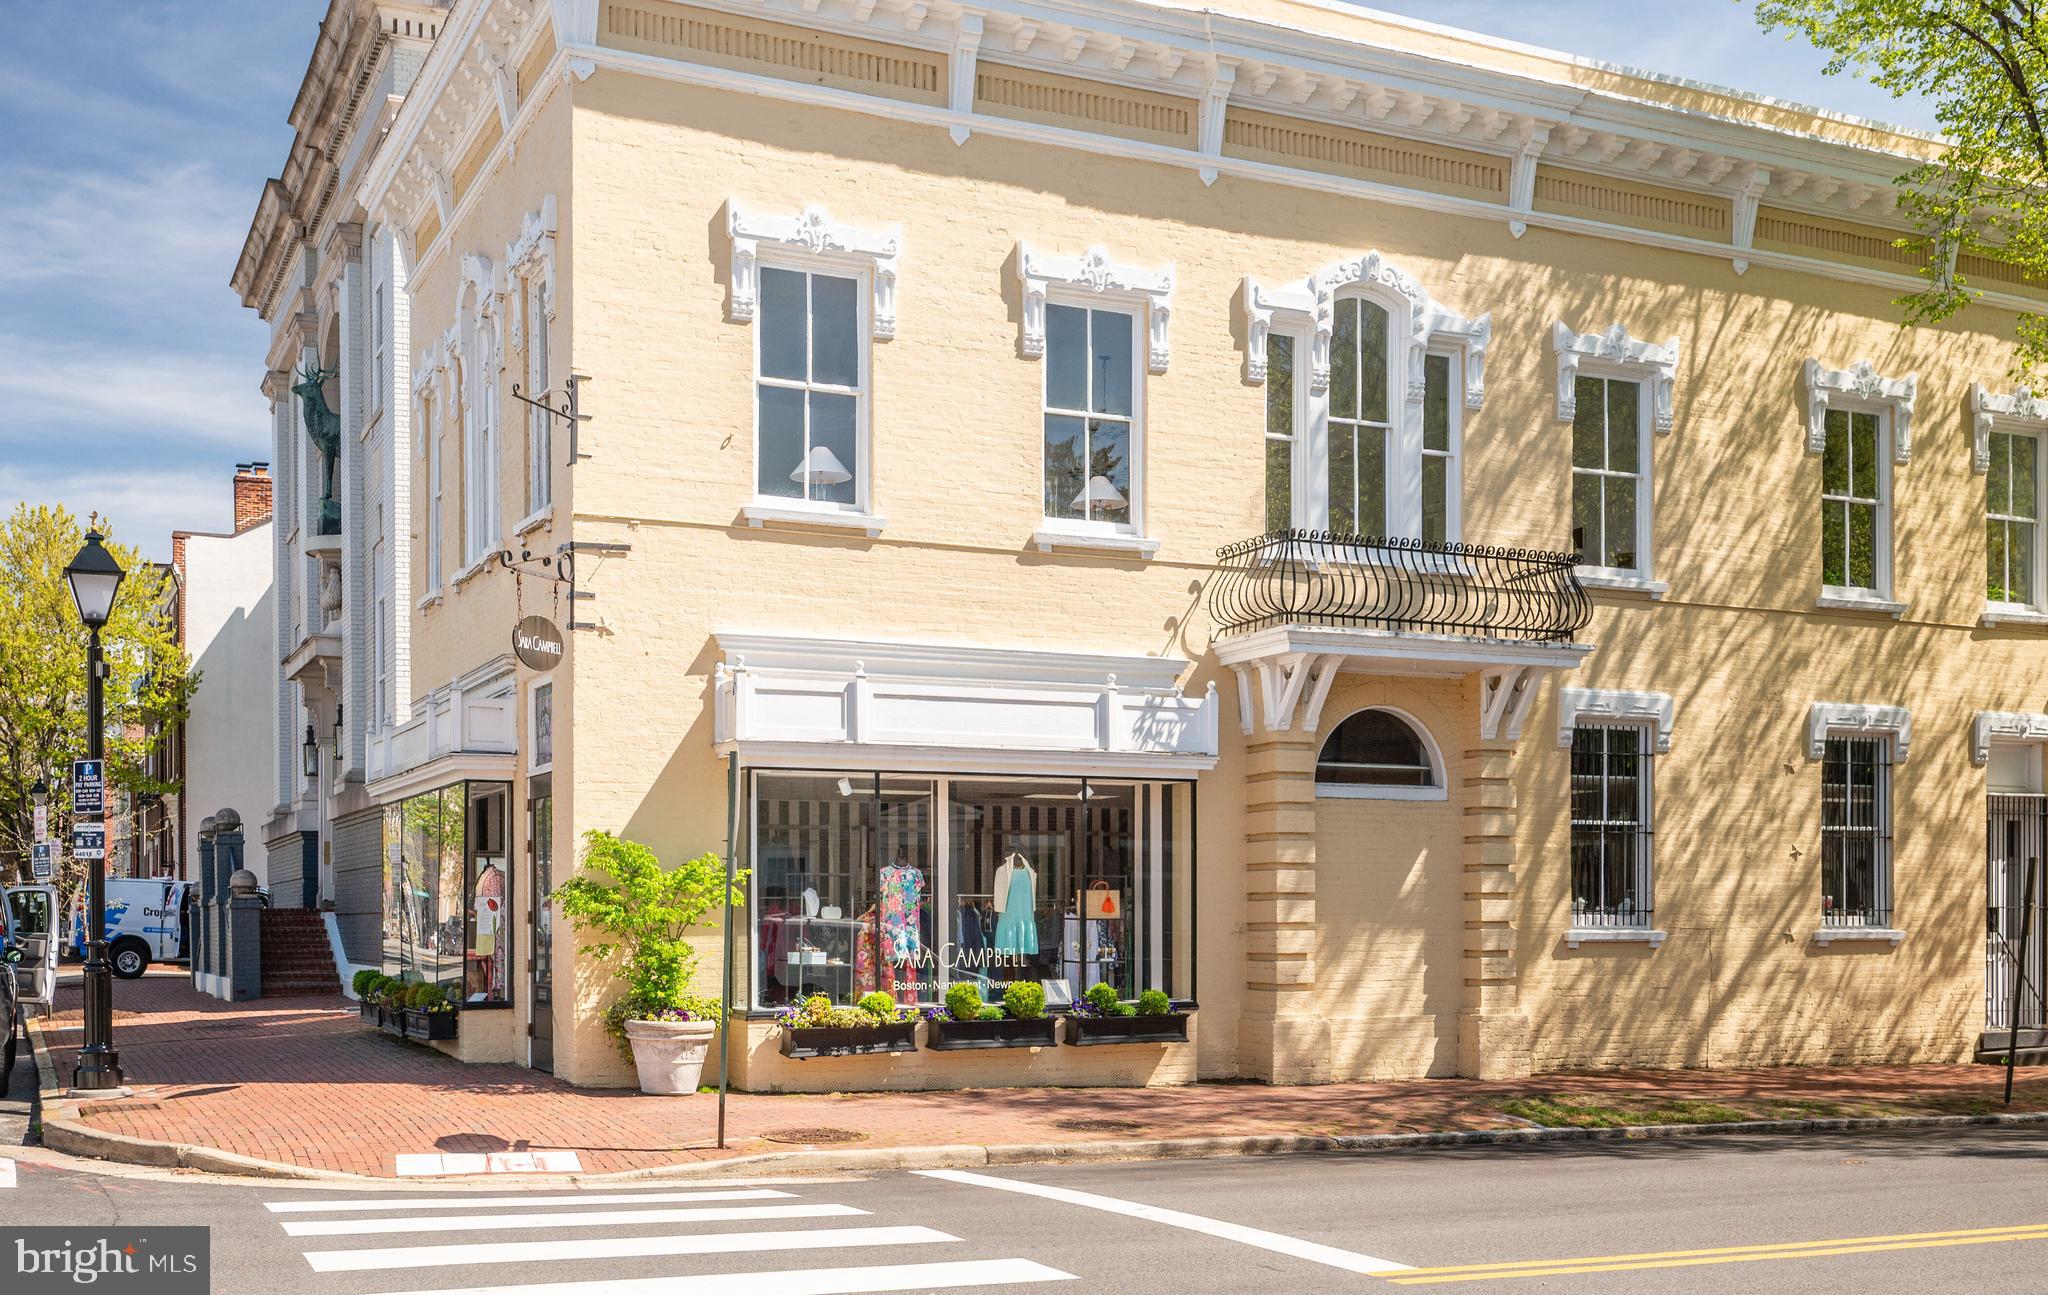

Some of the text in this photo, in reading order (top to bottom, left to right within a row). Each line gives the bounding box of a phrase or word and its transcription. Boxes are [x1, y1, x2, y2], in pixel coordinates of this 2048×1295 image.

[518, 630, 561, 655] SARA CAMPBELL
[83, 774, 98, 782] HOUR
[894, 938, 1027, 969] SARA CAMPBELL
[894, 980, 928, 991] Boston
